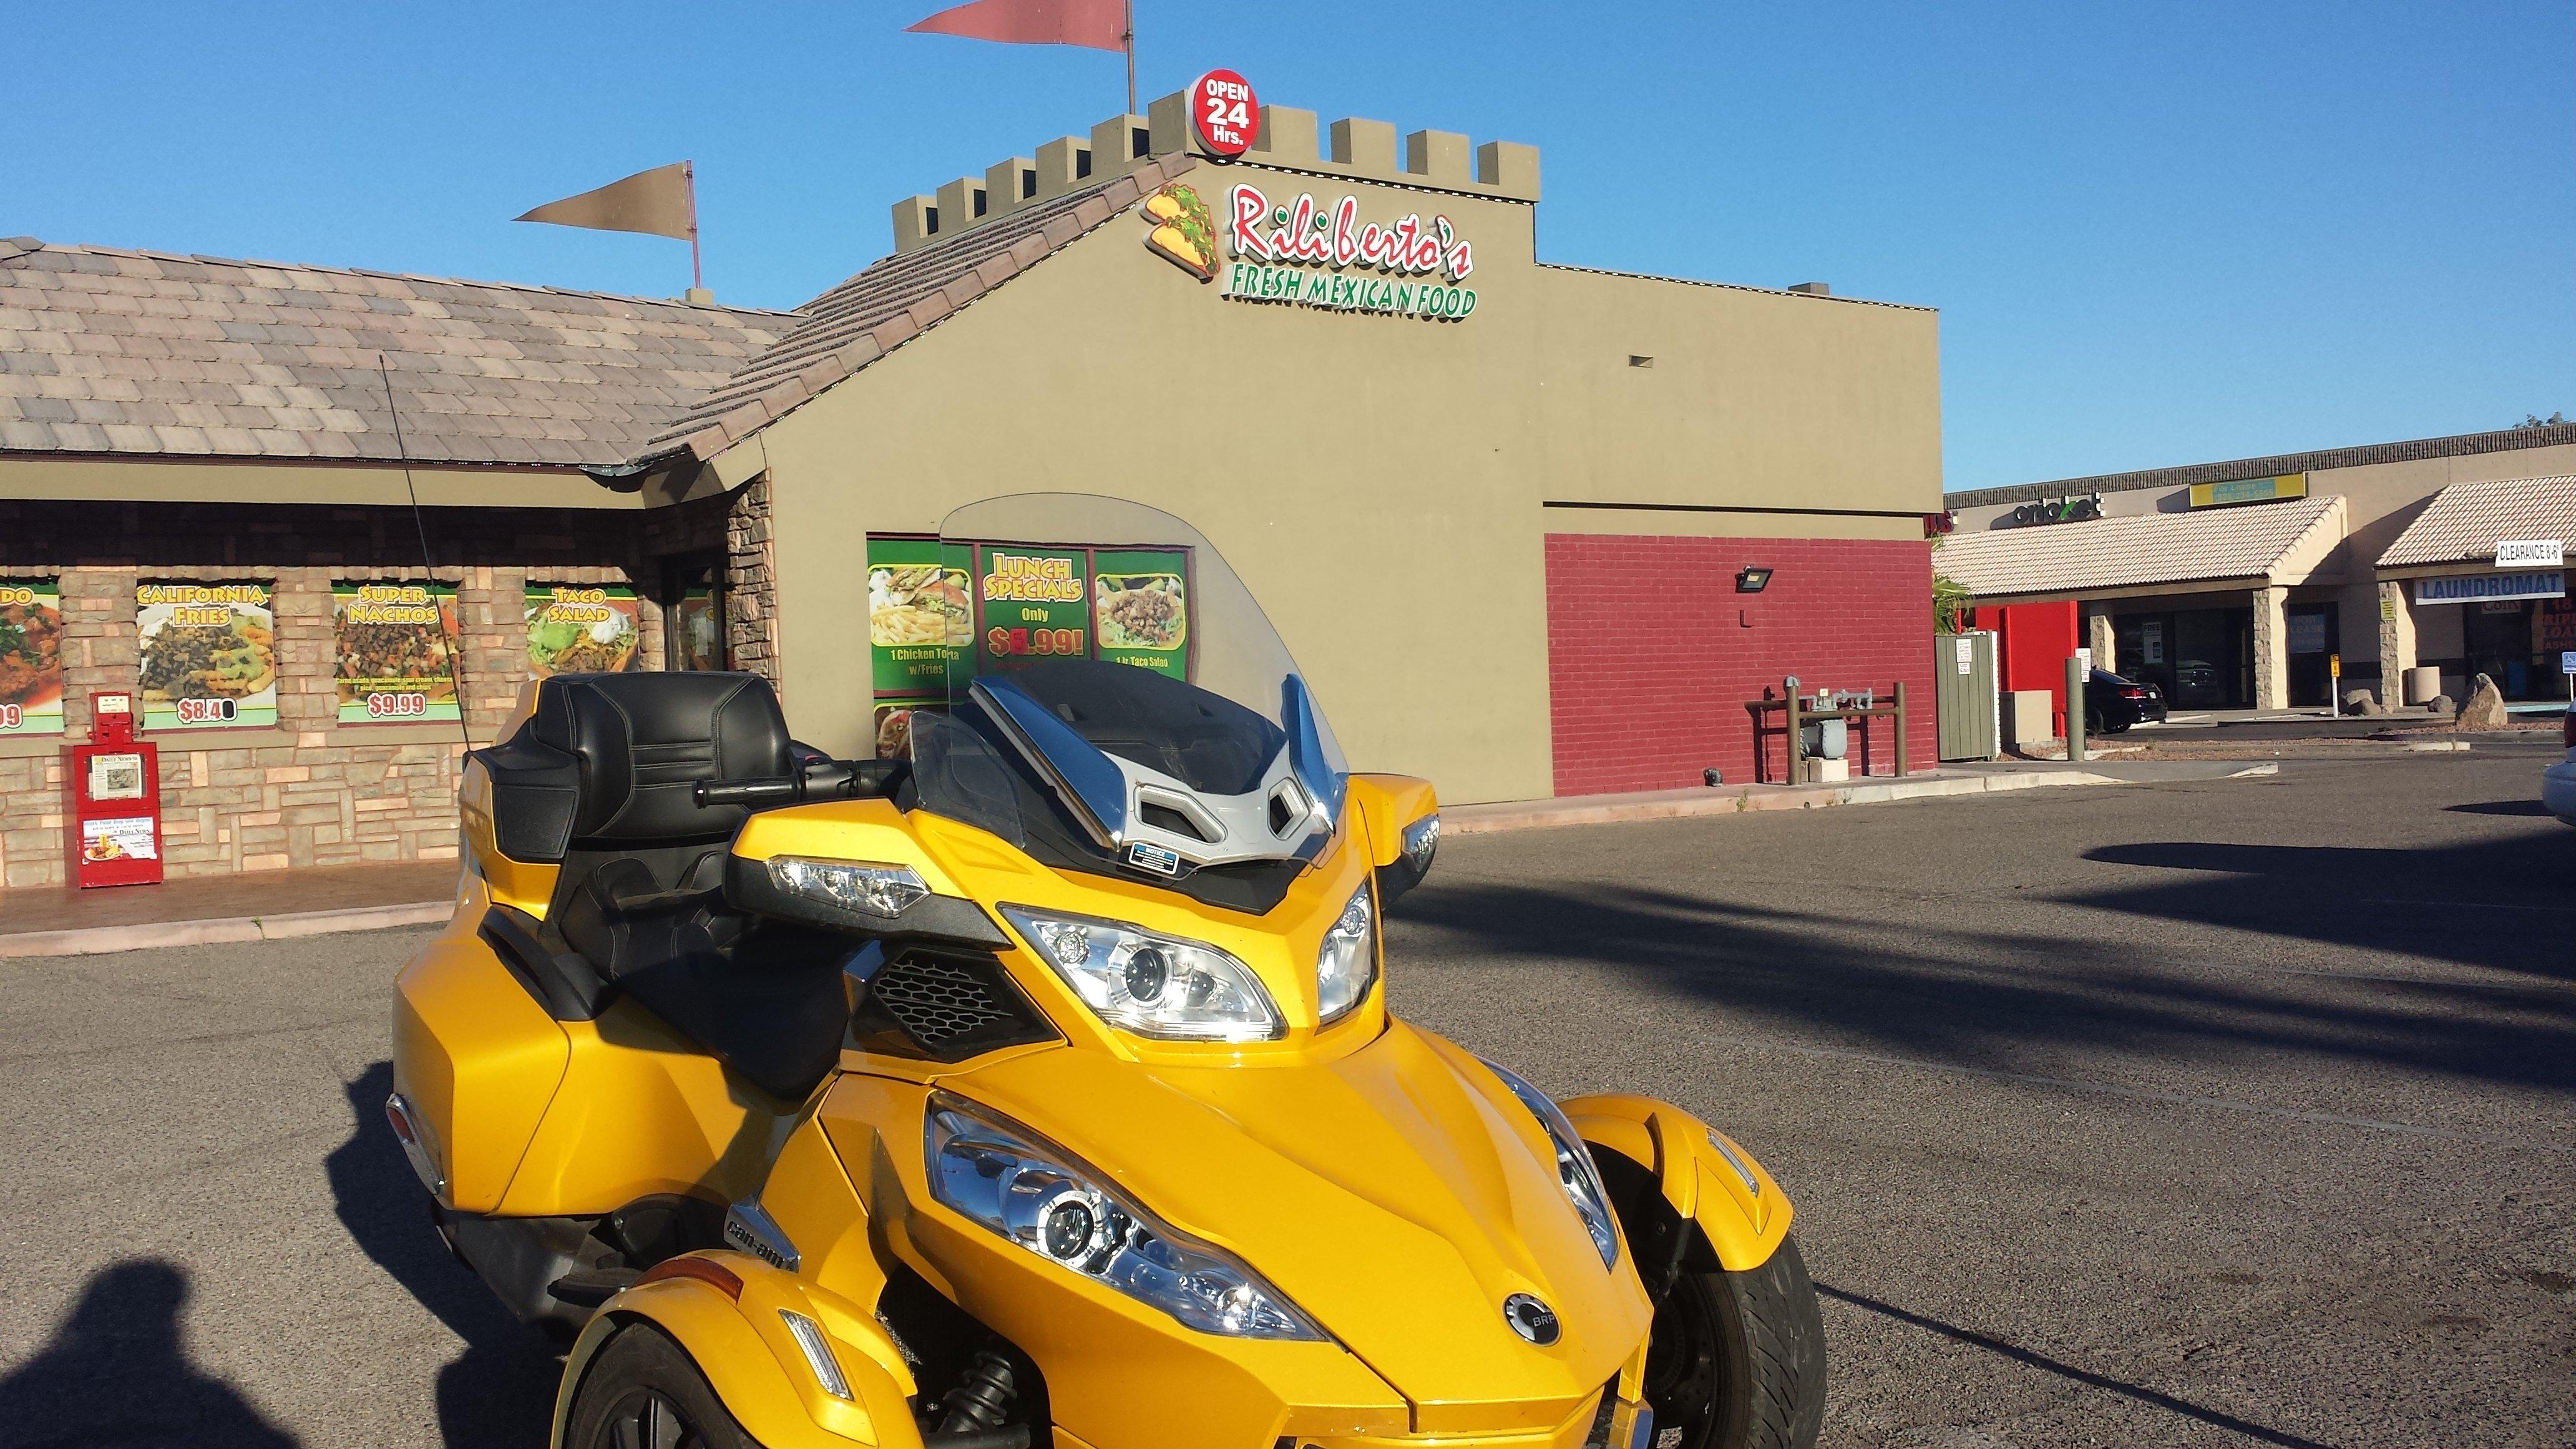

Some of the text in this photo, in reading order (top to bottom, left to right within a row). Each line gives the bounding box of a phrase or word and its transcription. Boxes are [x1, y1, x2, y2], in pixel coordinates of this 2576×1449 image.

[1206, 79, 1249, 102] OPEN
[1206, 97, 1250, 129] 24
[1213, 124, 1244, 145] Hrs.
[1232, 183, 1473, 280] Riliberto's
[1231, 263, 1478, 318] FRESH MEXICAN FOOD
[2500, 544, 2545, 561] CLEARANCE
[994, 555, 1071, 580] LUNCH
[137, 585, 266, 605] CALIFORNIA
[359, 585, 427, 603] SUPER
[984, 575, 1083, 600] SPECIALS
[2422, 573, 2559, 598] LAUNDROMAT
[553, 588, 605, 605] TACO
[173, 607, 230, 626] FRIES
[349, 605, 438, 623] NACHOS
[549, 606, 610, 623] SALAD
[1022, 607, 1049, 622] Only
[890, 649, 895, 660] 1
[897, 648, 935, 660] Chicken
[1130, 655, 1148, 666] Taco
[909, 664, 944, 675] w/Fries
[369, 695, 424, 716] $9.99
[1145, 847, 1166, 857] NOTICE
[727, 1221, 784, 1269] can-am
[1533, 1314, 1555, 1327] BRP
